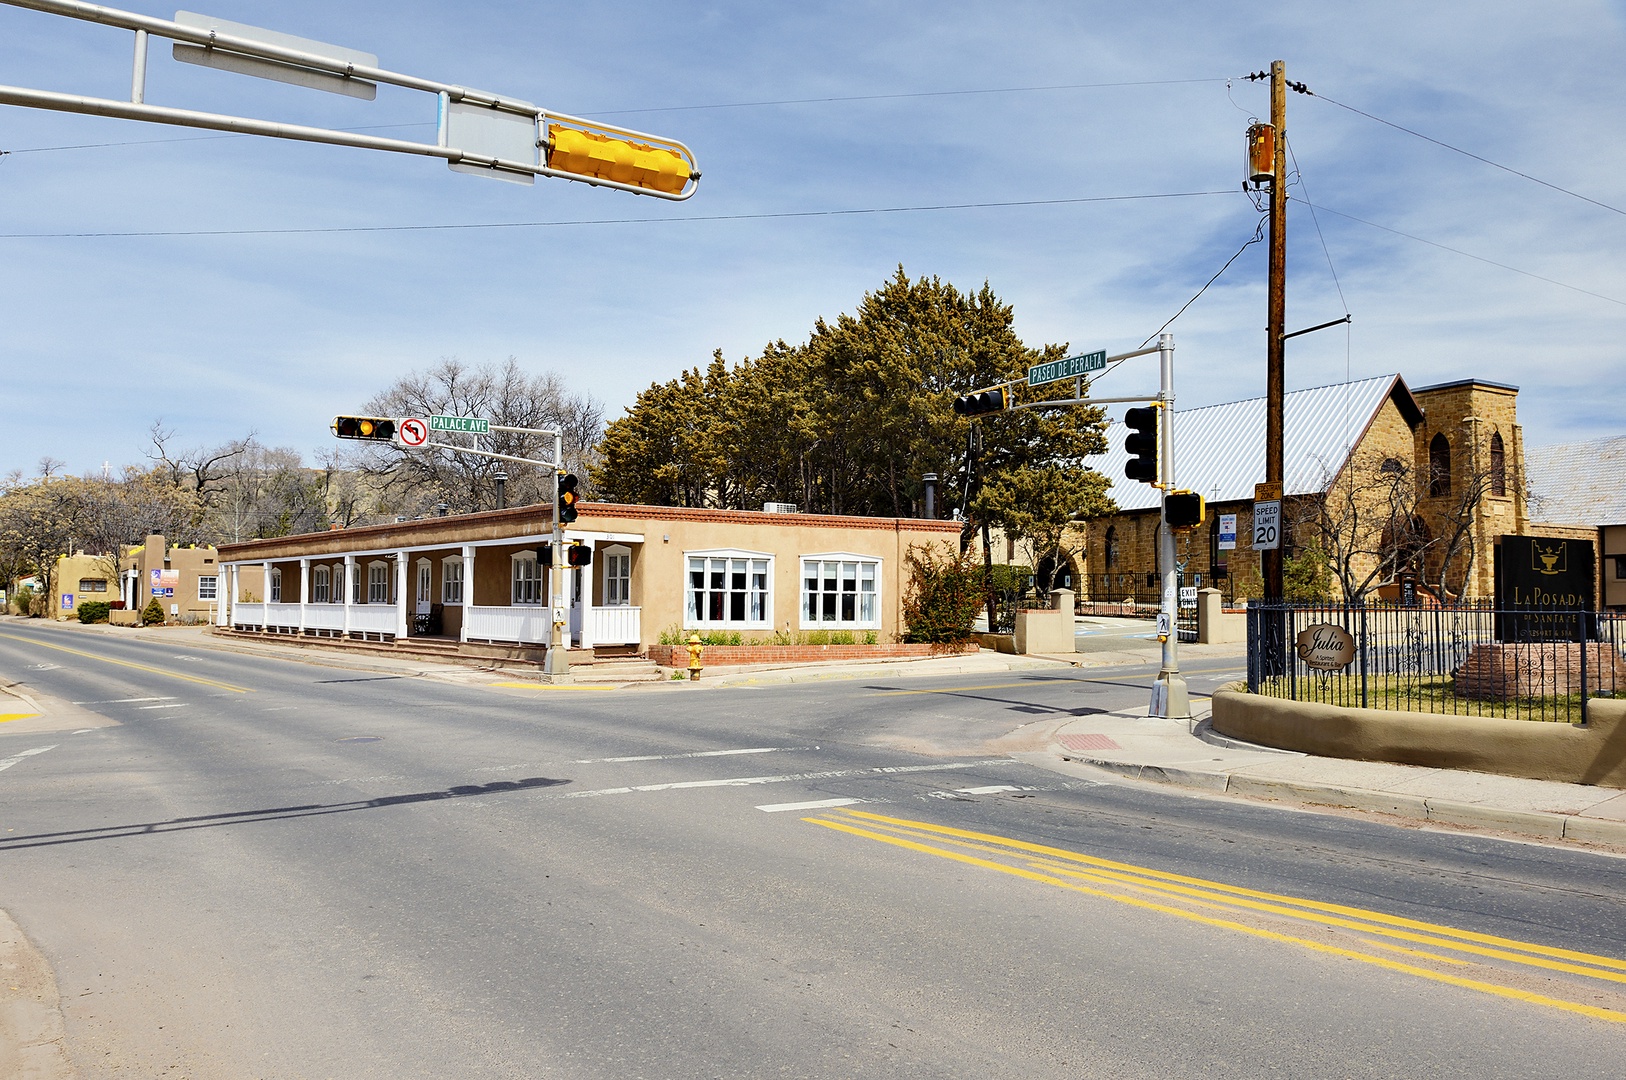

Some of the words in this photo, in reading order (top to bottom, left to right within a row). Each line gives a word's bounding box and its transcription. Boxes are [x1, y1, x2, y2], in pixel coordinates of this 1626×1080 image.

[1032, 364, 1056, 383] PASEO
[1058, 361, 1068, 377] DE
[1070, 353, 1102, 374] PERALTA
[432, 416, 467, 430] PALACE
[470, 420, 487, 431] AVE
[1255, 484, 1281, 492] PEDESTRIAN
[1256, 506, 1278, 515] SPEED
[1256, 526, 1276, 543] 20
[1181, 588, 1196, 597] EXIT
[1534, 587, 1584, 606] POSADA
[1181, 597, 1197, 606] ONLY
[1299, 627, 1345, 659] Julia
